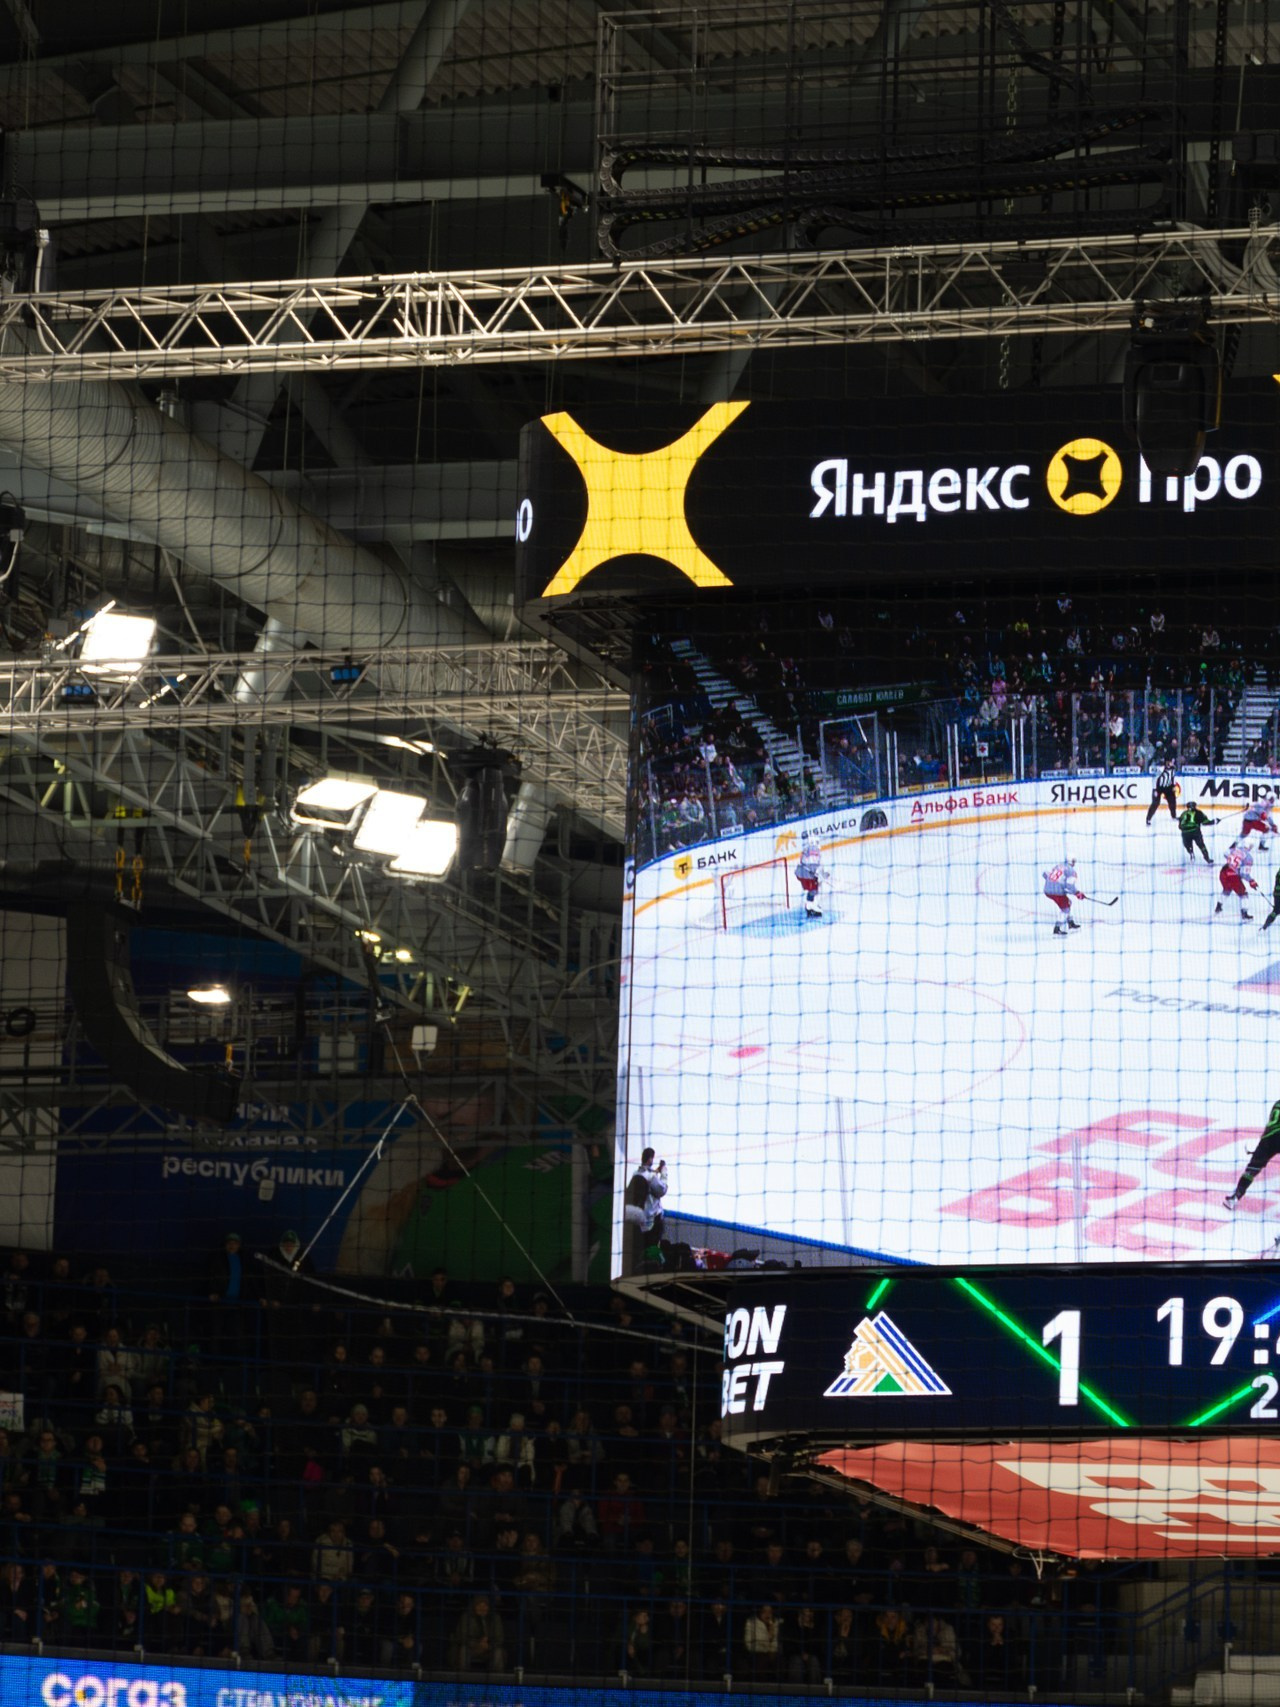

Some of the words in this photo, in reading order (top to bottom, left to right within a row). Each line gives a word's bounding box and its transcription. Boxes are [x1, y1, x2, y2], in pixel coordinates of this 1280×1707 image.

[810, 458, 1030, 523] Яндекс
[911, 795, 968, 818] Альфа
[973, 791, 1019, 807] Банк
[1050, 782, 1138, 804] Яндекс
[697, 849, 737, 870] БАНК
[162, 1156, 345, 1187] республики
[1043, 1310, 1081, 1406] 1
[1251, 1374, 1279, 1419] 2
